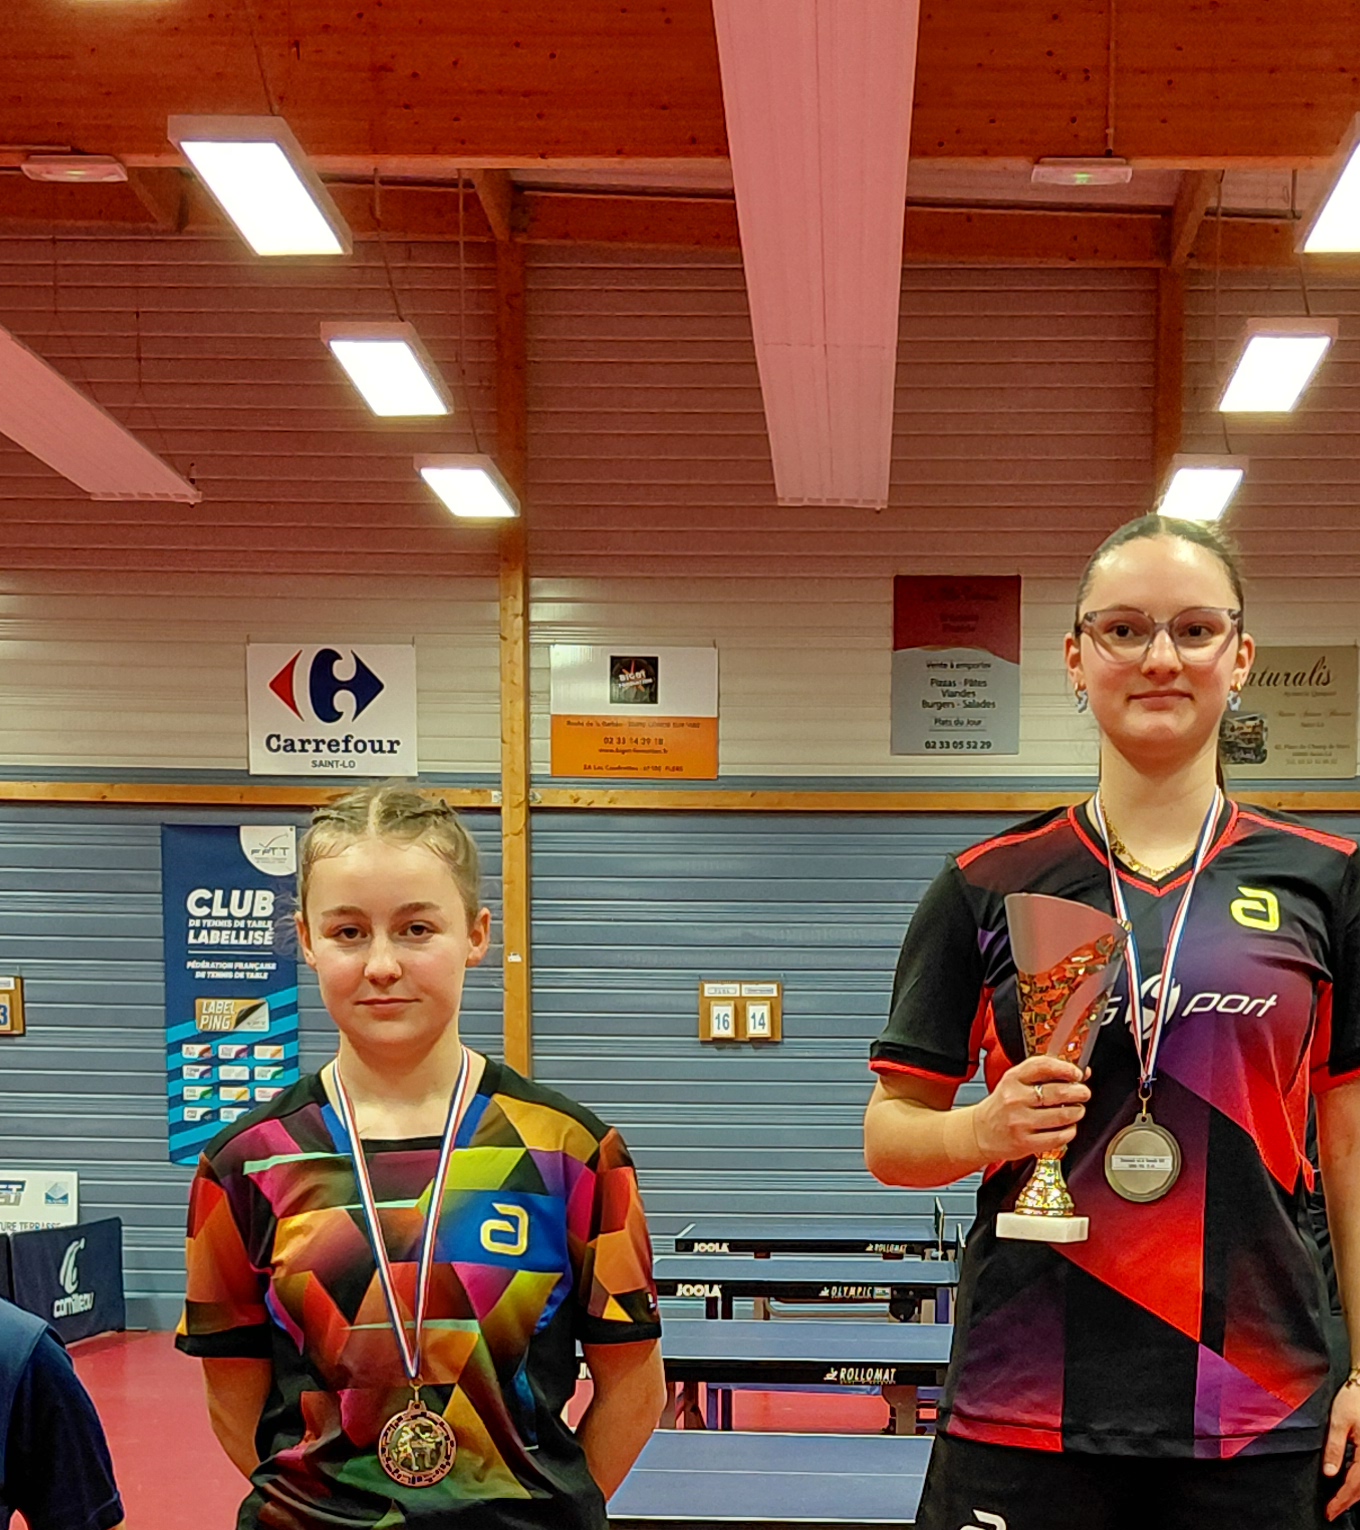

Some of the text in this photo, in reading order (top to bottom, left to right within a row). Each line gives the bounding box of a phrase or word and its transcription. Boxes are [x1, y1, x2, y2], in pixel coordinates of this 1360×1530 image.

[1245, 655, 1332, 687] aturalis
[265, 733, 402, 755] Carrefour
[924, 740, 937, 750] 02
[939, 740, 951, 750] 33
[311, 759, 357, 769] SAINT-LO
[186, 888, 276, 918] CLUB
[188, 918, 274, 930] DE TENNIS DE TABLE
[187, 926, 276, 946] LABELLISÉ
[201, 1000, 236, 1014] LABEL
[199, 1014, 231, 1031] PING
[714, 1012, 730, 1031] 16
[750, 1011, 766, 1030] 14
[20, 1221, 61, 1232] TERRASS
[692, 1242, 729, 1254] JOOLA
[675, 1283, 873, 1299] JOOLA OLYMPIC
[839, 1367, 897, 1382] ROLLOMAT
